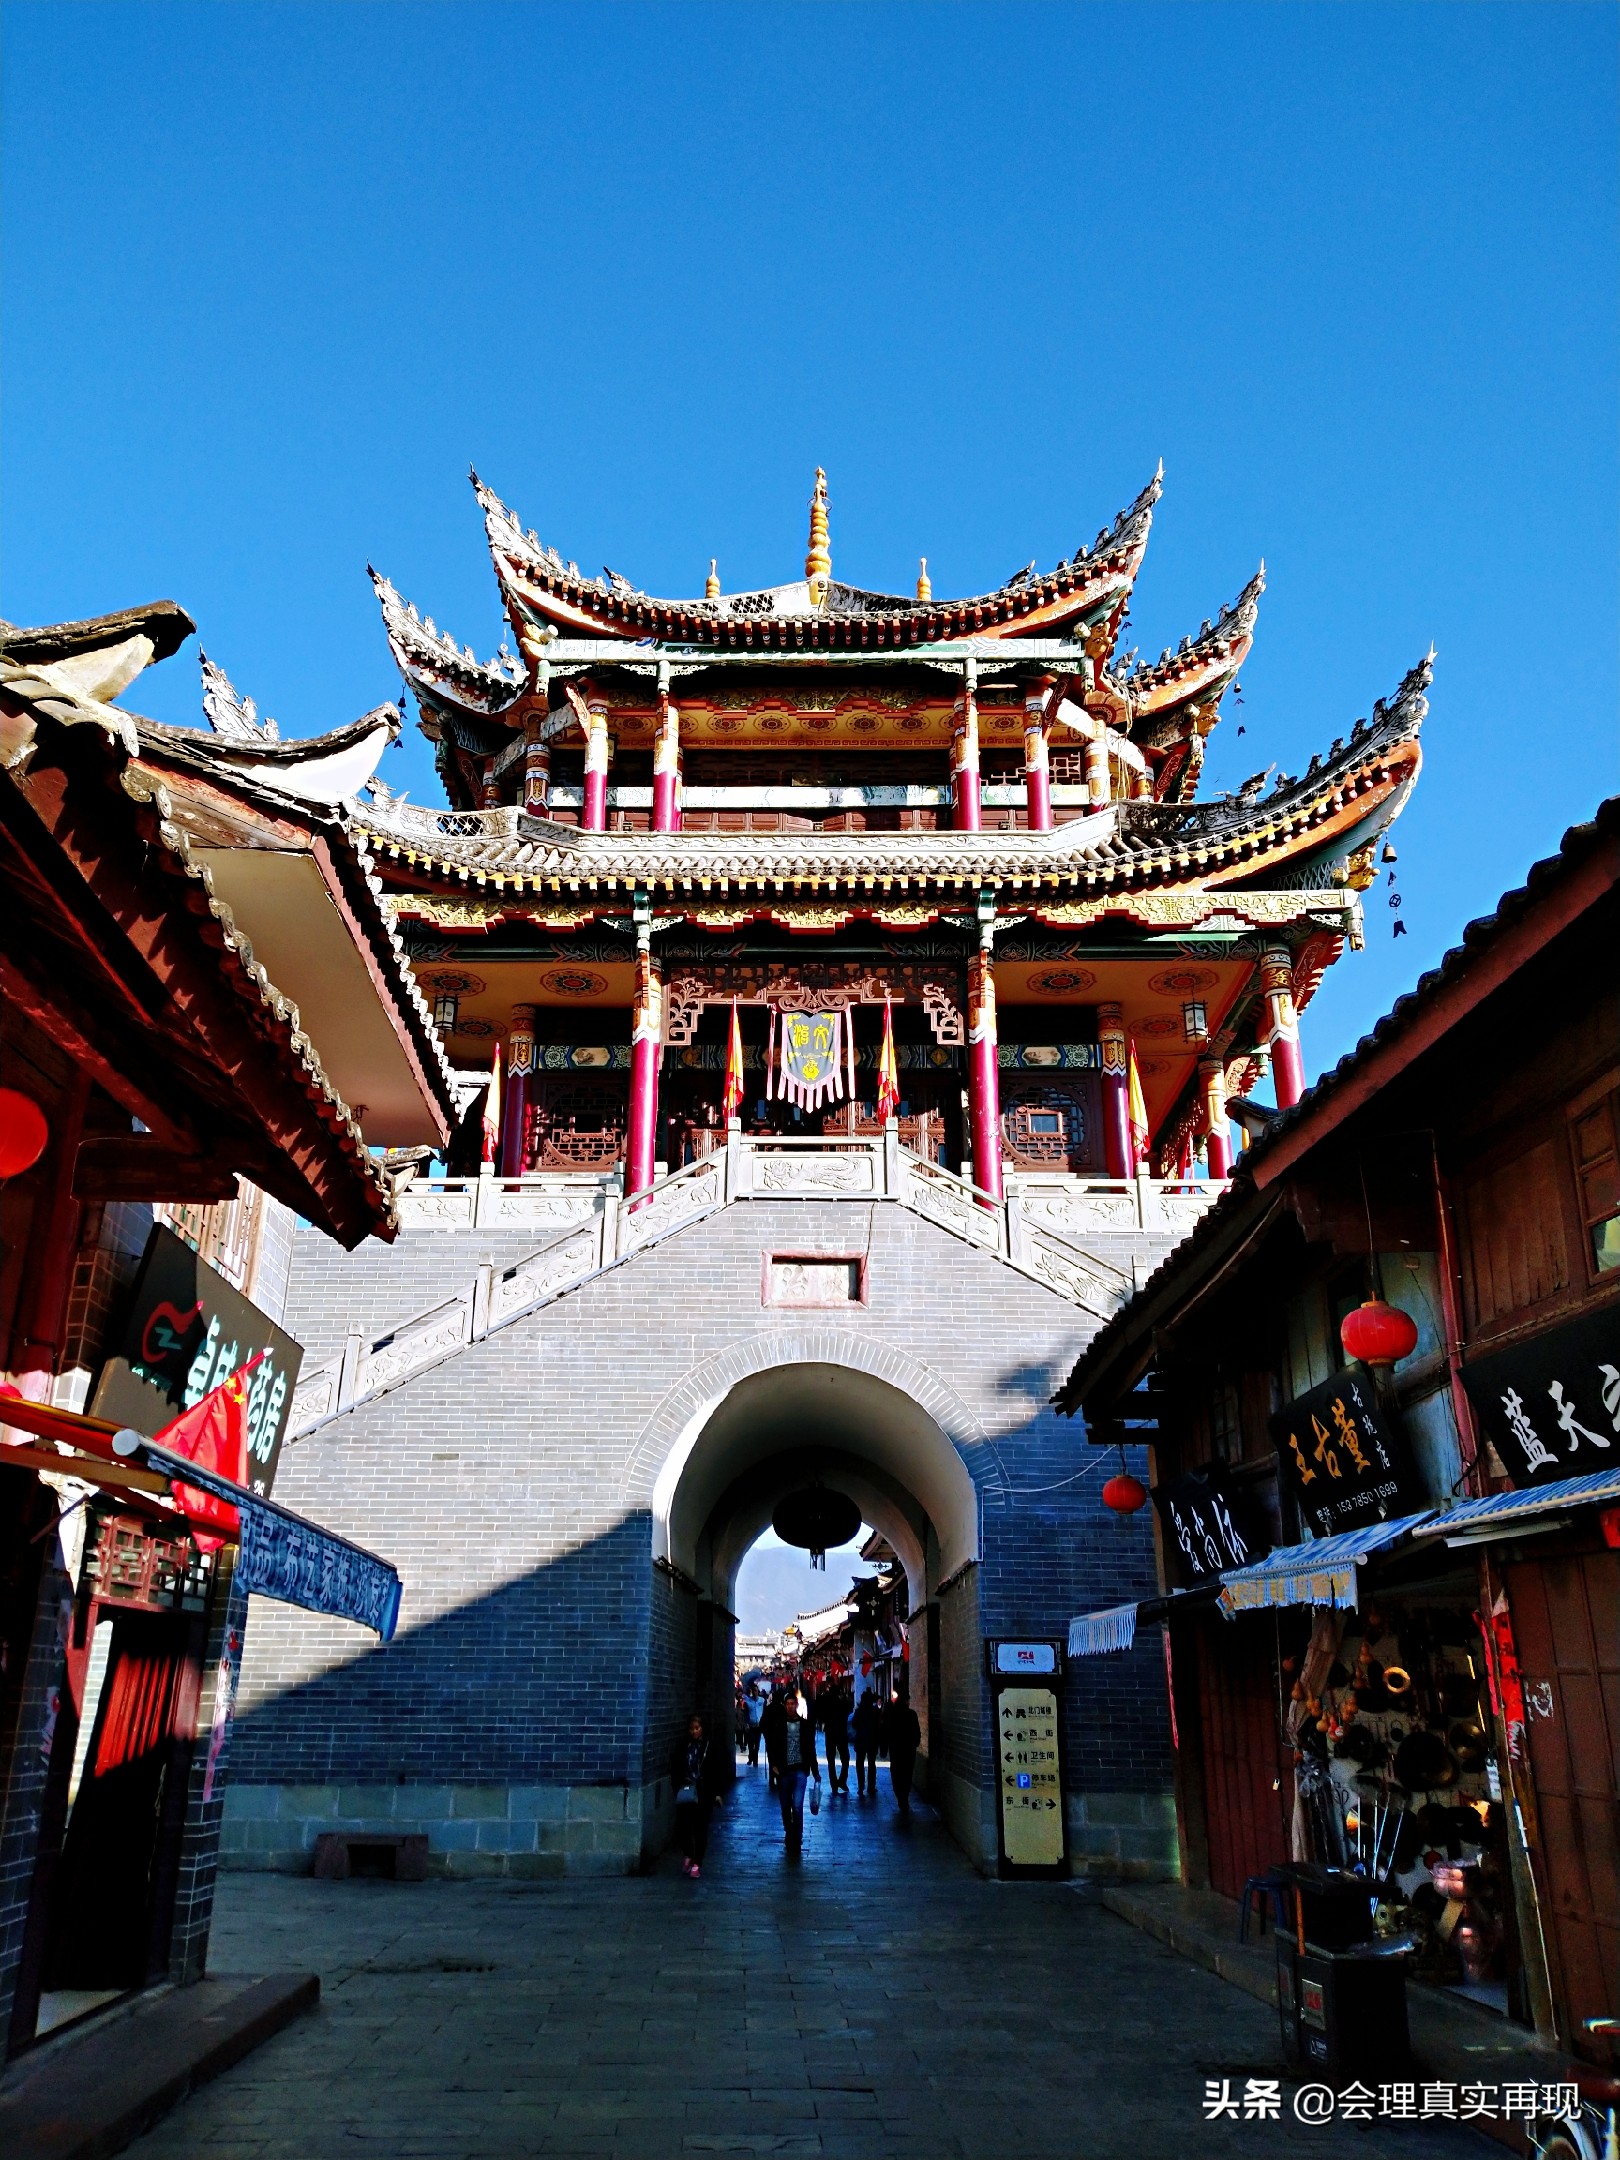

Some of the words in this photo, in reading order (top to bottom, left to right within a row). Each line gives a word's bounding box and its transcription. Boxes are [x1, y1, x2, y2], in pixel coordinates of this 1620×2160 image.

[1030, 1751, 1055, 1761] 卫生间
[1031, 1774, 1056, 1783] 停车场
